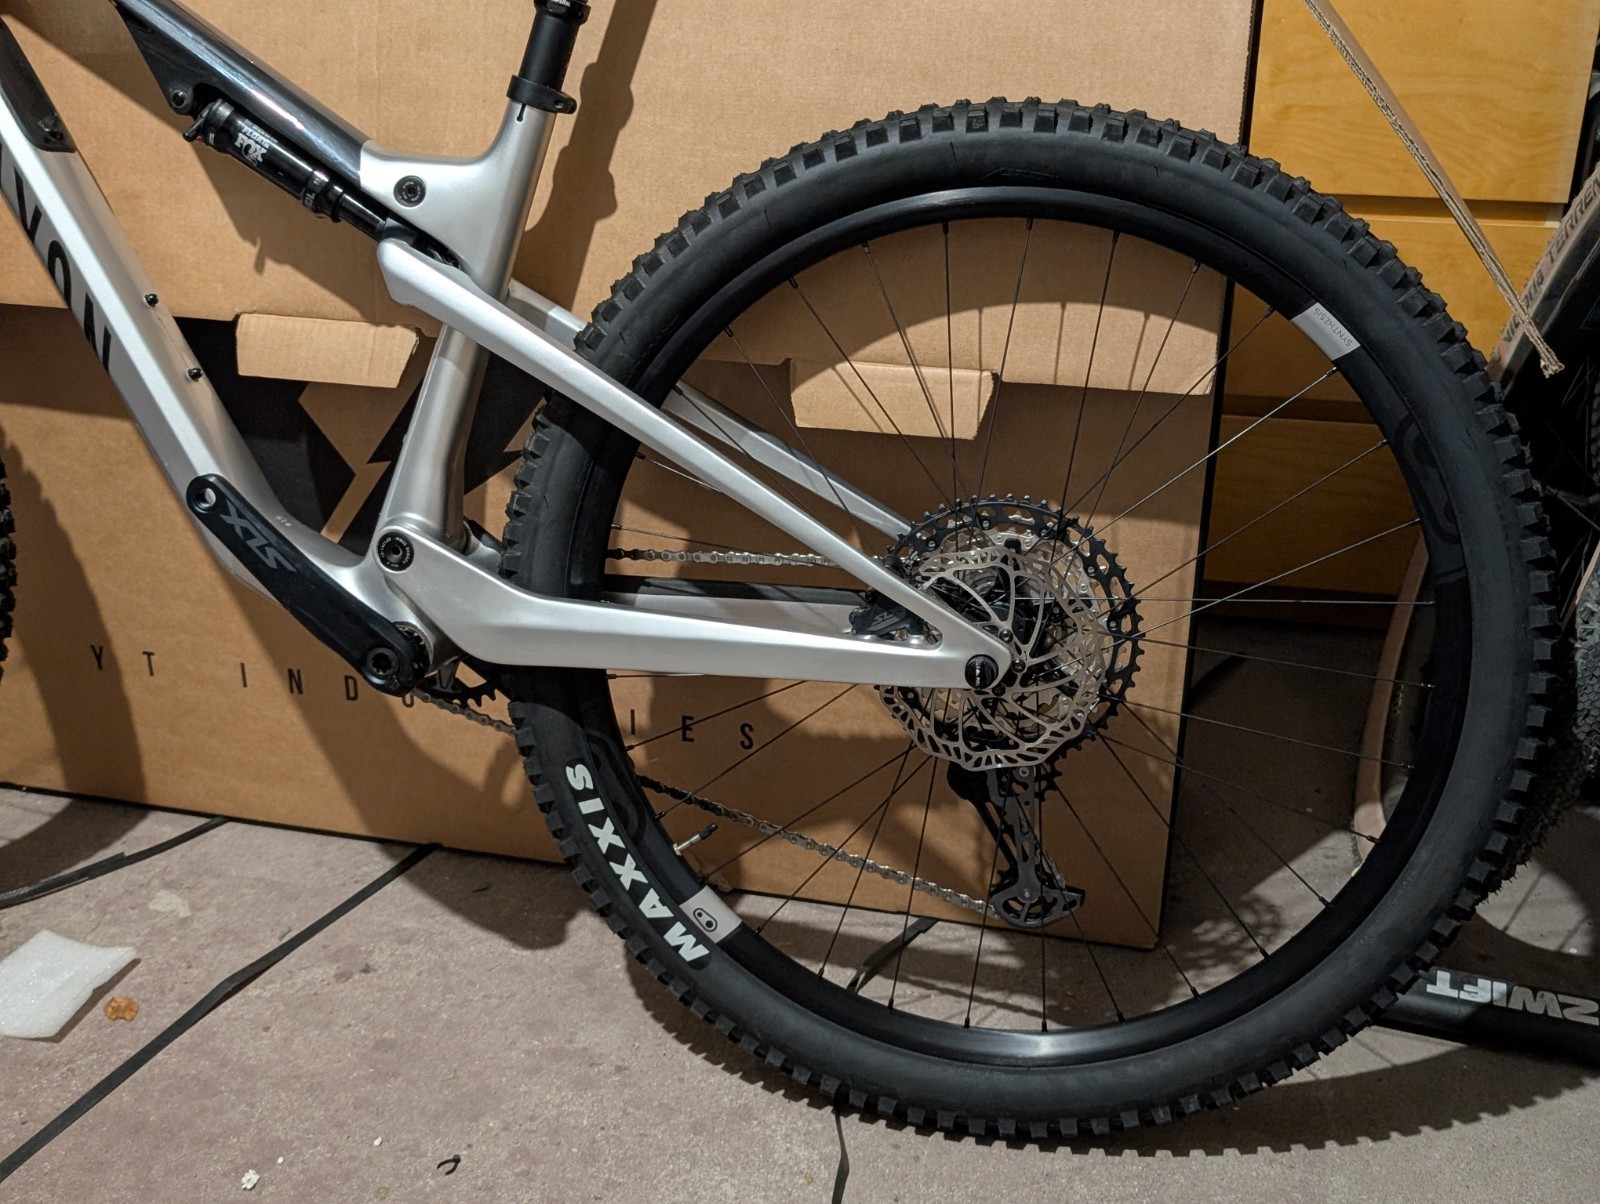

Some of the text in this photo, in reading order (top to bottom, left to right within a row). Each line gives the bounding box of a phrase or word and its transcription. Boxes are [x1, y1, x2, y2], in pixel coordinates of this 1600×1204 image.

[234, 133, 268, 166] FOX
[1313, 307, 1352, 347] SYNTHESIS
[220, 499, 297, 572] SLX
[90, 644, 155, 677] YT
[565, 763, 710, 962] MAXXIS
[1426, 970, 1600, 1026] ZWIFT
